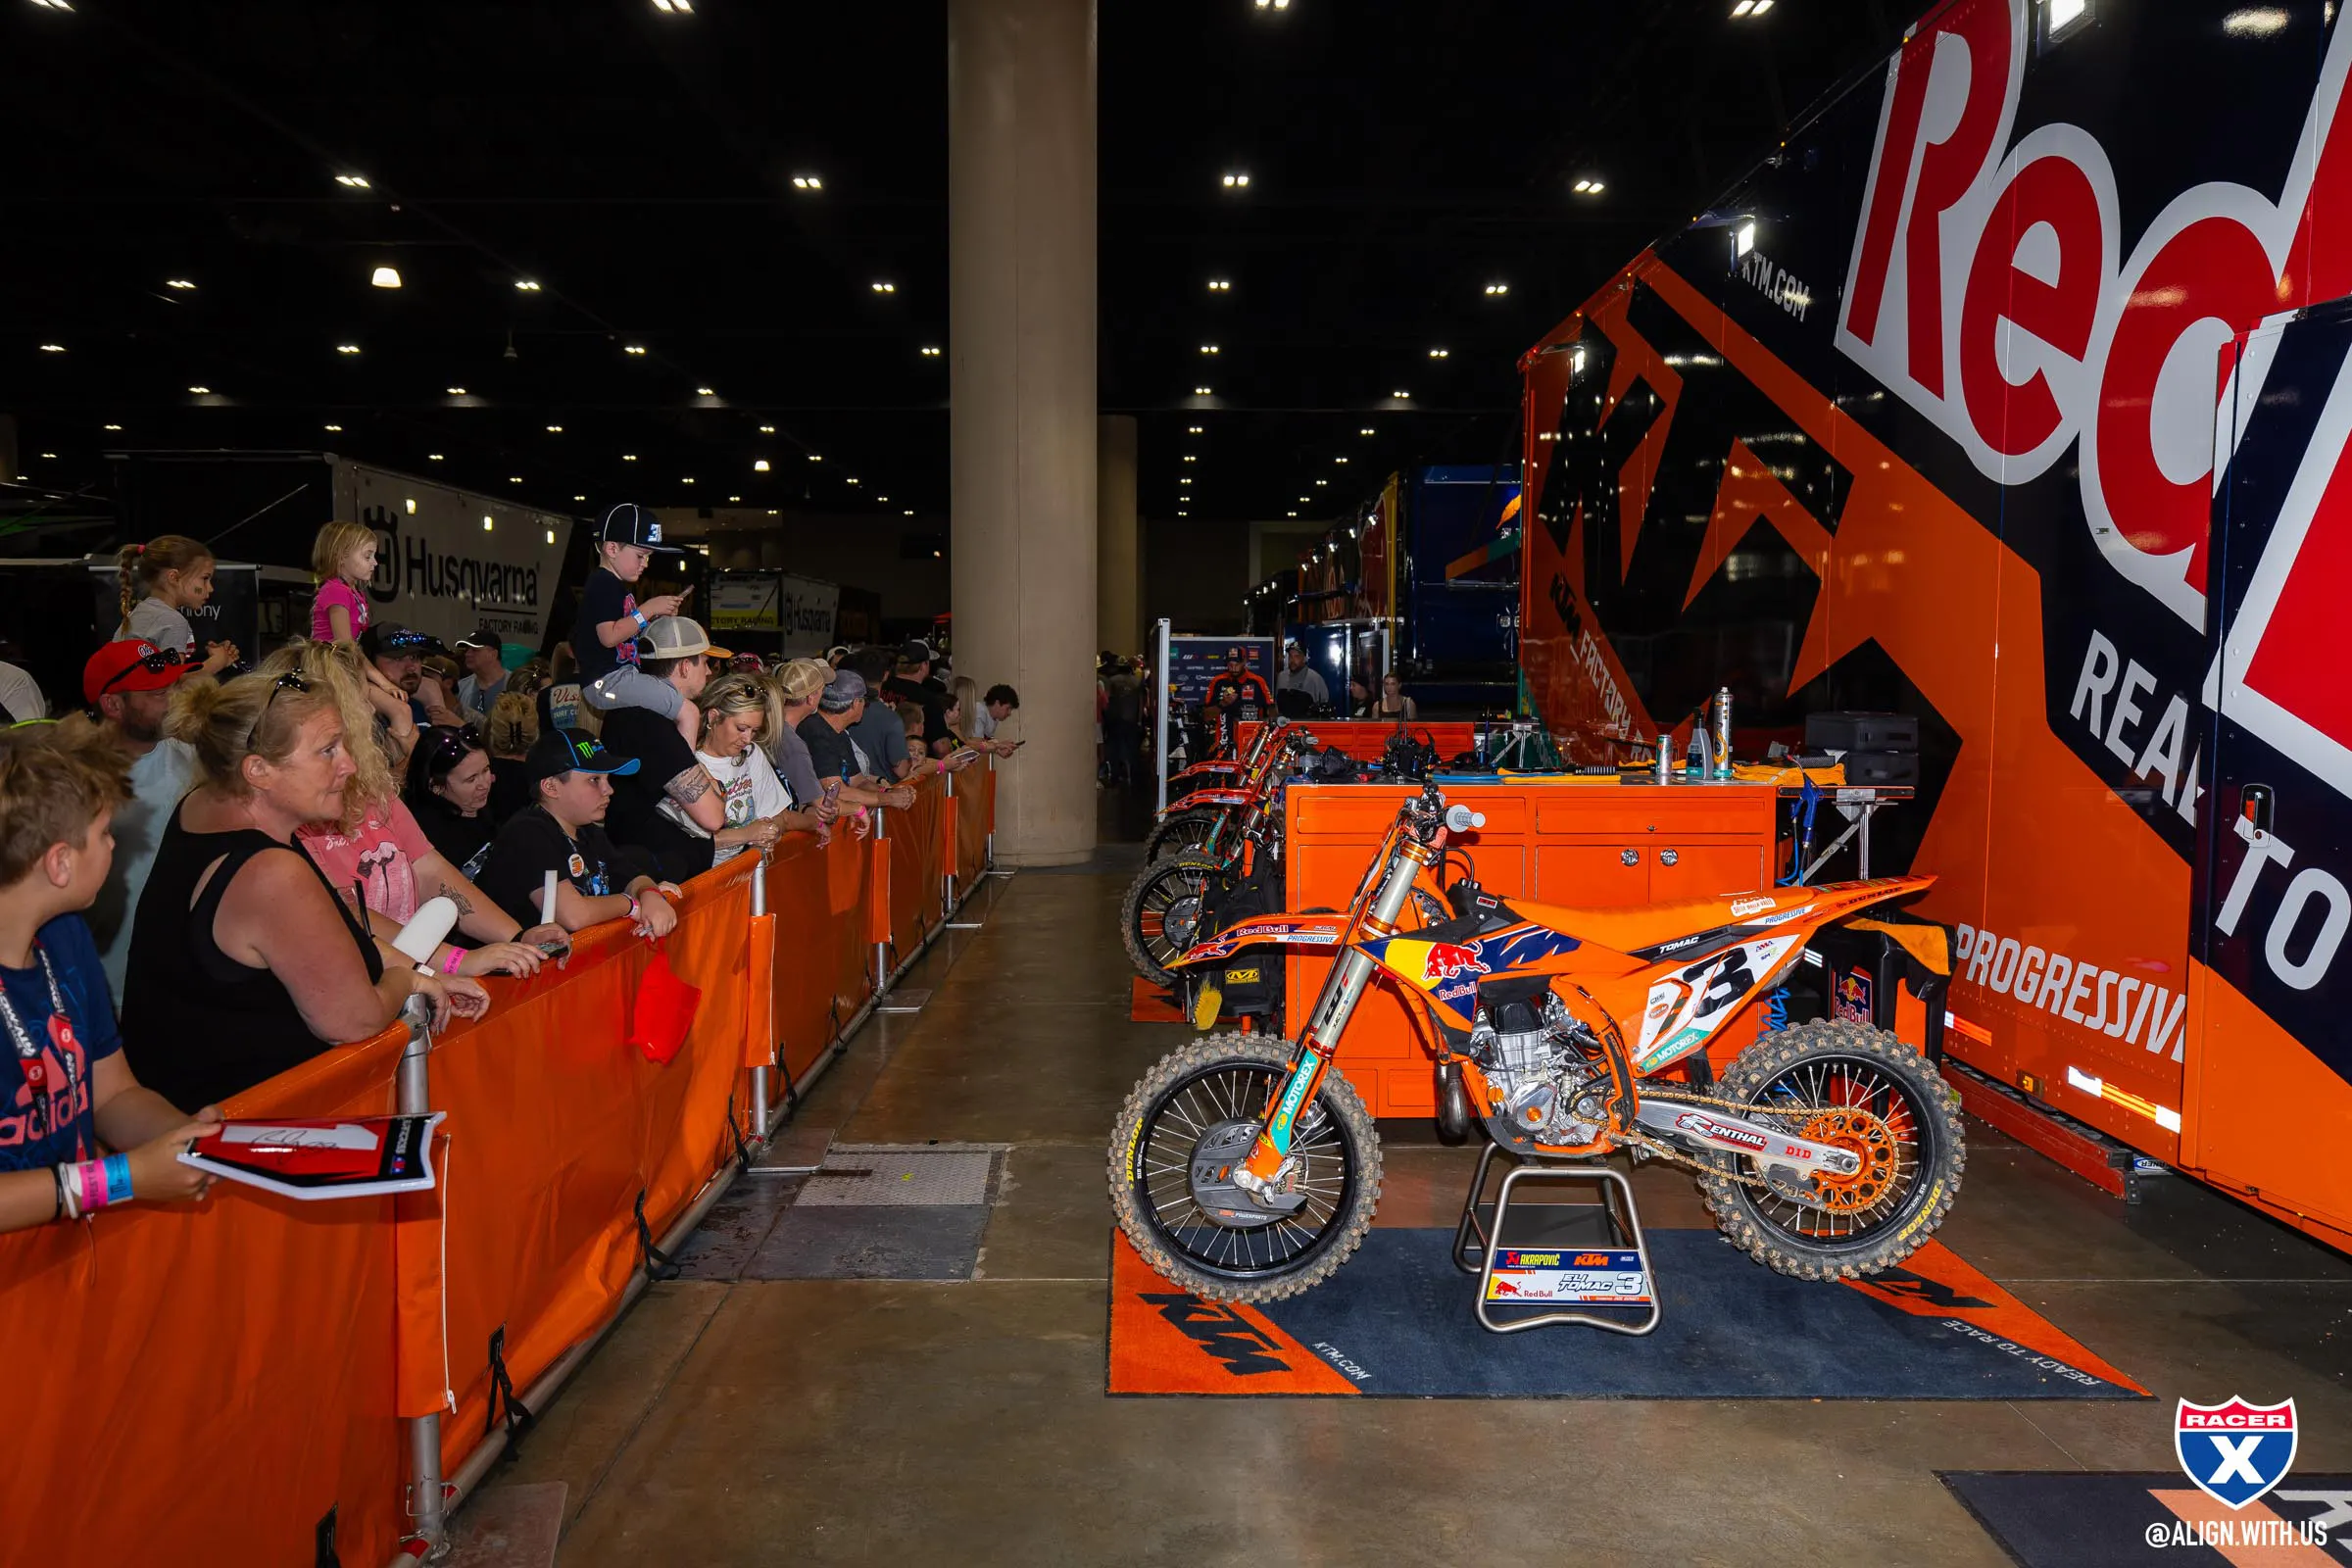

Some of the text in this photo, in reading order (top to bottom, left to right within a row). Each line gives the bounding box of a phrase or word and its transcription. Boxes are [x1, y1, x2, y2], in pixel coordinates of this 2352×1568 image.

[406, 536, 539, 611] Husqvarna
[1847, 886, 1903, 905] DUNLOP
[2214, 812, 2352, 991] TO
[1765, 907, 1807, 925] PROGRESSIVE
[1237, 924, 1289, 937] Red Bull
[1287, 934, 1337, 944] PROGRESSIVE
[1659, 936, 1699, 955] TOMAC
[1439, 981, 1478, 1002] Red Bull
[1682, 947, 1756, 1018] 3
[1835, 994, 1870, 1024] Red Bull
[1657, 1034, 1699, 1060] MOTOREX
[1285, 1058, 1316, 1115] MOTOREX
[1679, 1113, 1766, 1147] RENTHAL
[1126, 1117, 1144, 1182] DUNLOP
[1786, 1145, 1812, 1160] DID
[1896, 1185, 1944, 1242] DUNLOP
[1573, 1253, 1609, 1266] KTM
[1557, 1272, 1643, 1295] TOMAC 3
[1561, 1274, 1589, 1283] ELI
[1941, 1319, 2000, 1346] RACE
[2026, 1355, 2103, 1386] READY
